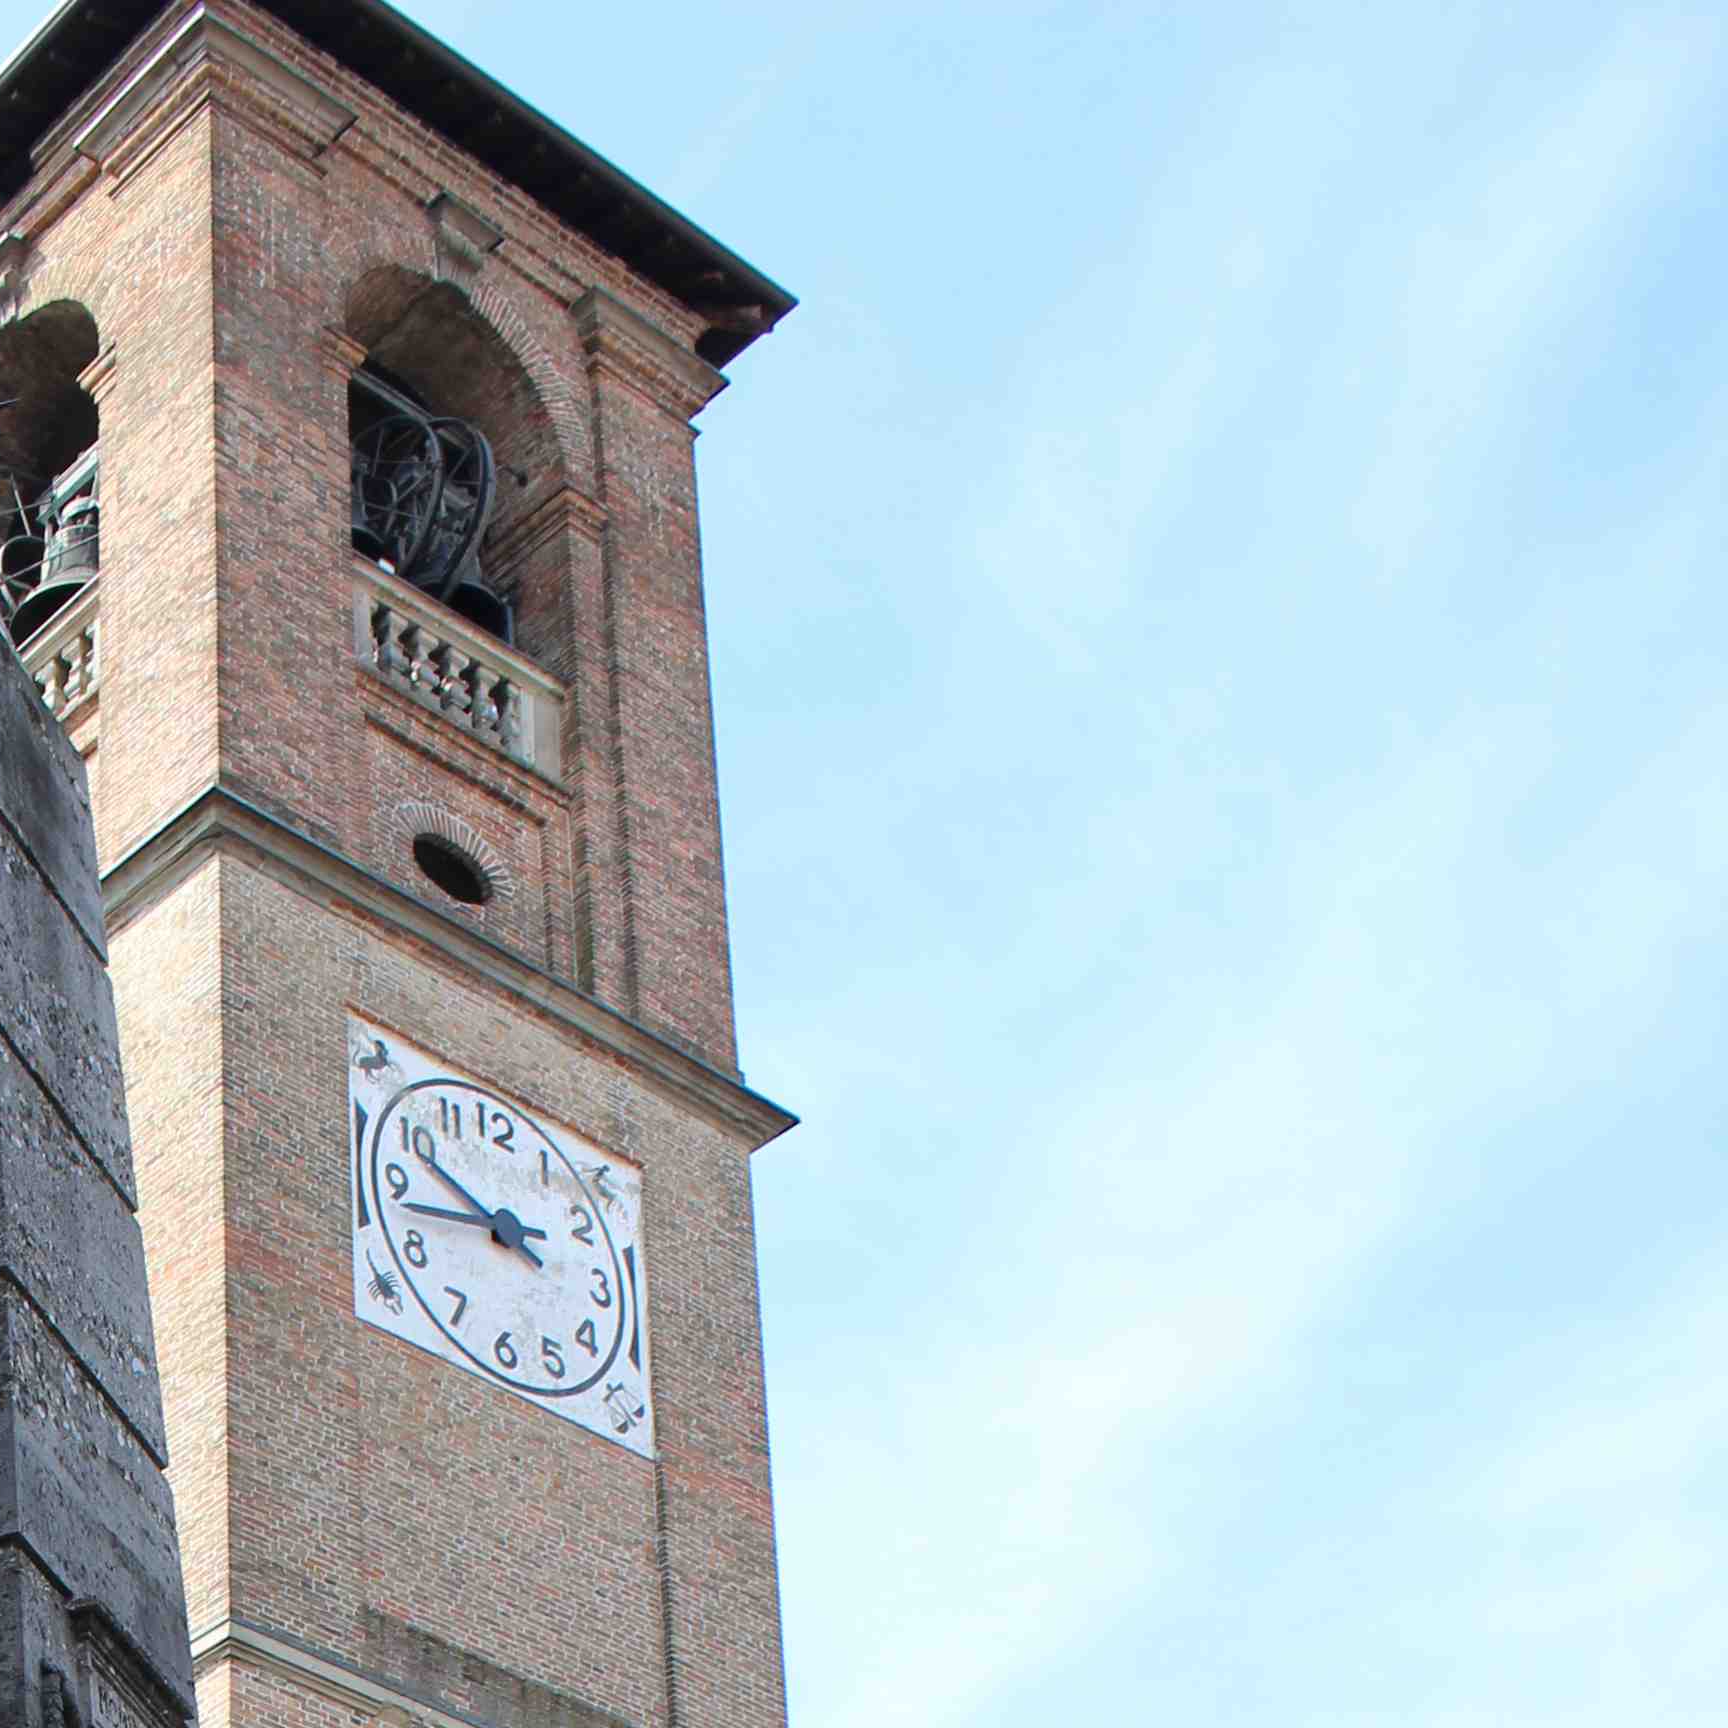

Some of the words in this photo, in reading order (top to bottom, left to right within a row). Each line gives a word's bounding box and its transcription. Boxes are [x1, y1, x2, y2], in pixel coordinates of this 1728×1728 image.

[439, 1097, 462, 1138] 11
[476, 1102, 516, 1153] 12
[400, 1116, 435, 1162] 10
[385, 1163, 409, 1200] 9
[539, 1150, 549, 1186] 1
[571, 1205, 593, 1246] 2
[403, 1229, 428, 1269] 8
[444, 1286, 468, 1326] 7
[590, 1268, 611, 1308] 3
[494, 1331, 518, 1369] 6
[541, 1336, 565, 1379] 5
[576, 1319, 599, 1356] 4
